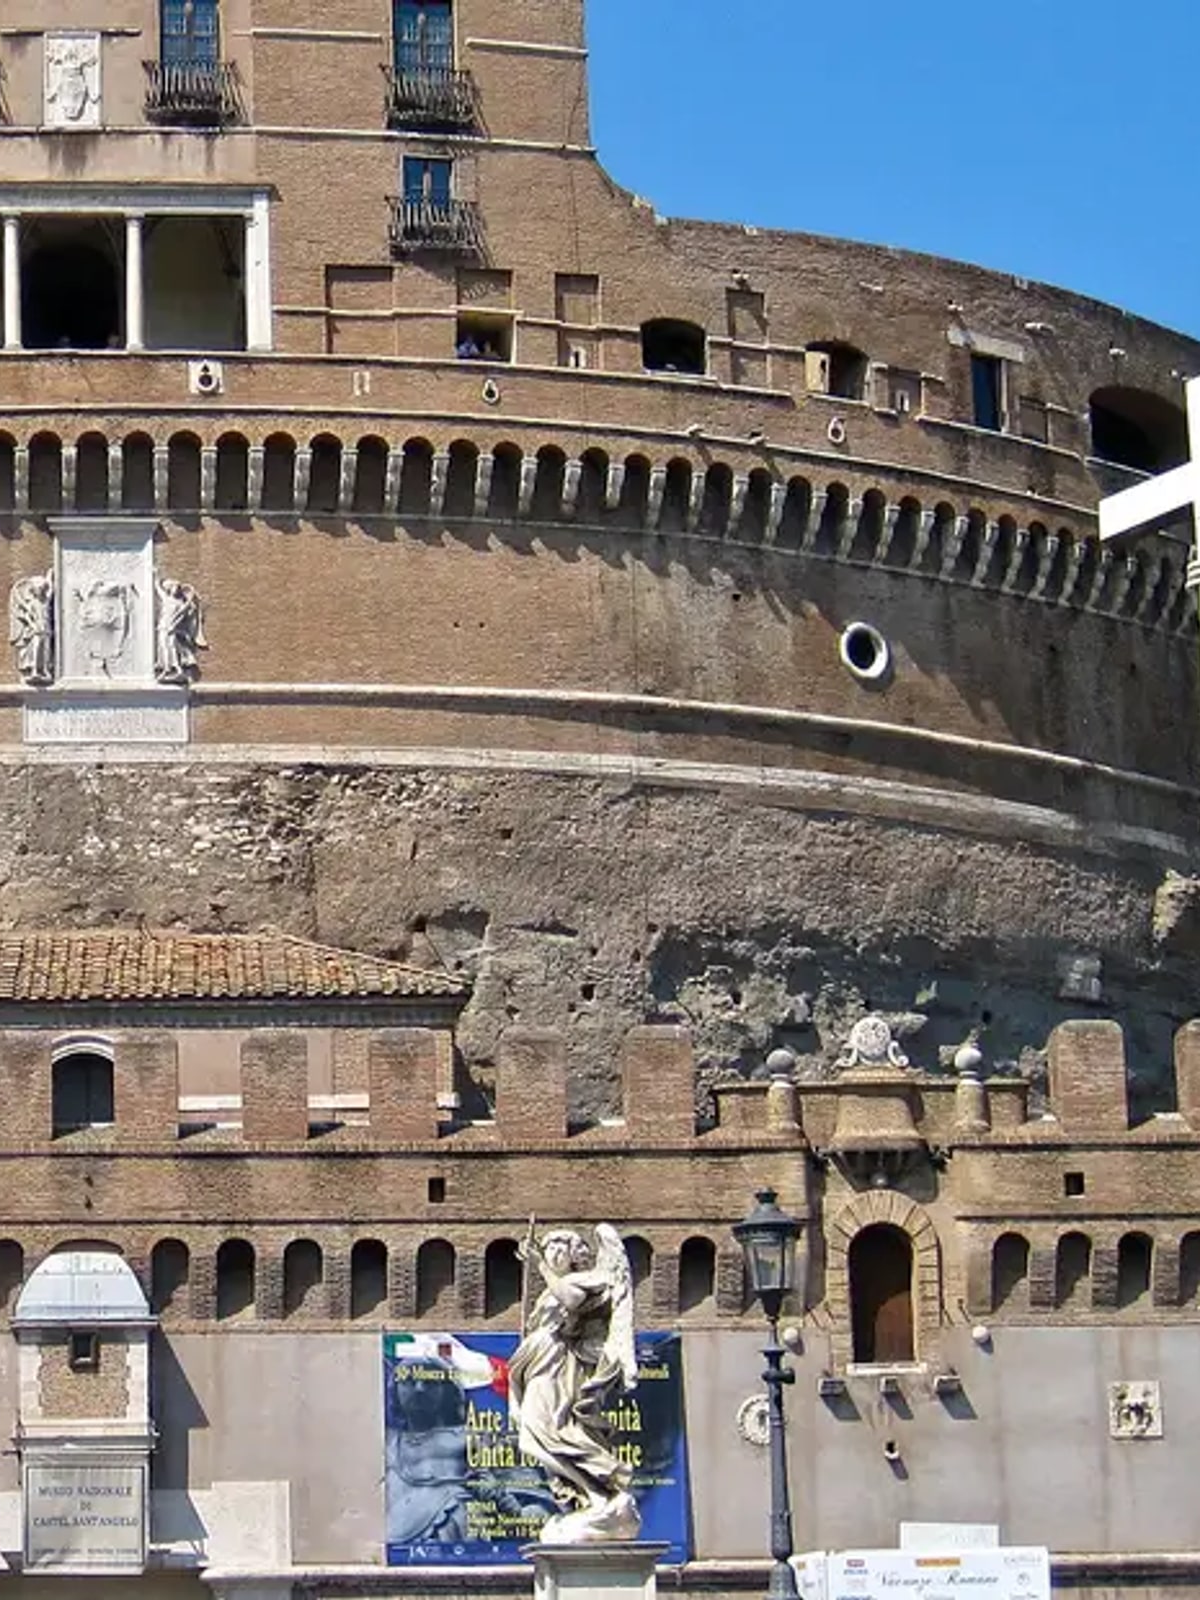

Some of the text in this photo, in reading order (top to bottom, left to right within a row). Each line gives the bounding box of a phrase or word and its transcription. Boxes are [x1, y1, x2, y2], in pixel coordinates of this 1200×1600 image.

[464, 1399, 502, 1432] Arte
[603, 1397, 642, 1433] nità
[614, 1442, 643, 1468] rte
[38, 1486, 133, 1497] MUSEO NAZIONALE
[80, 1501, 92, 1511] DI
[33, 1516, 70, 1527] CASTEL
